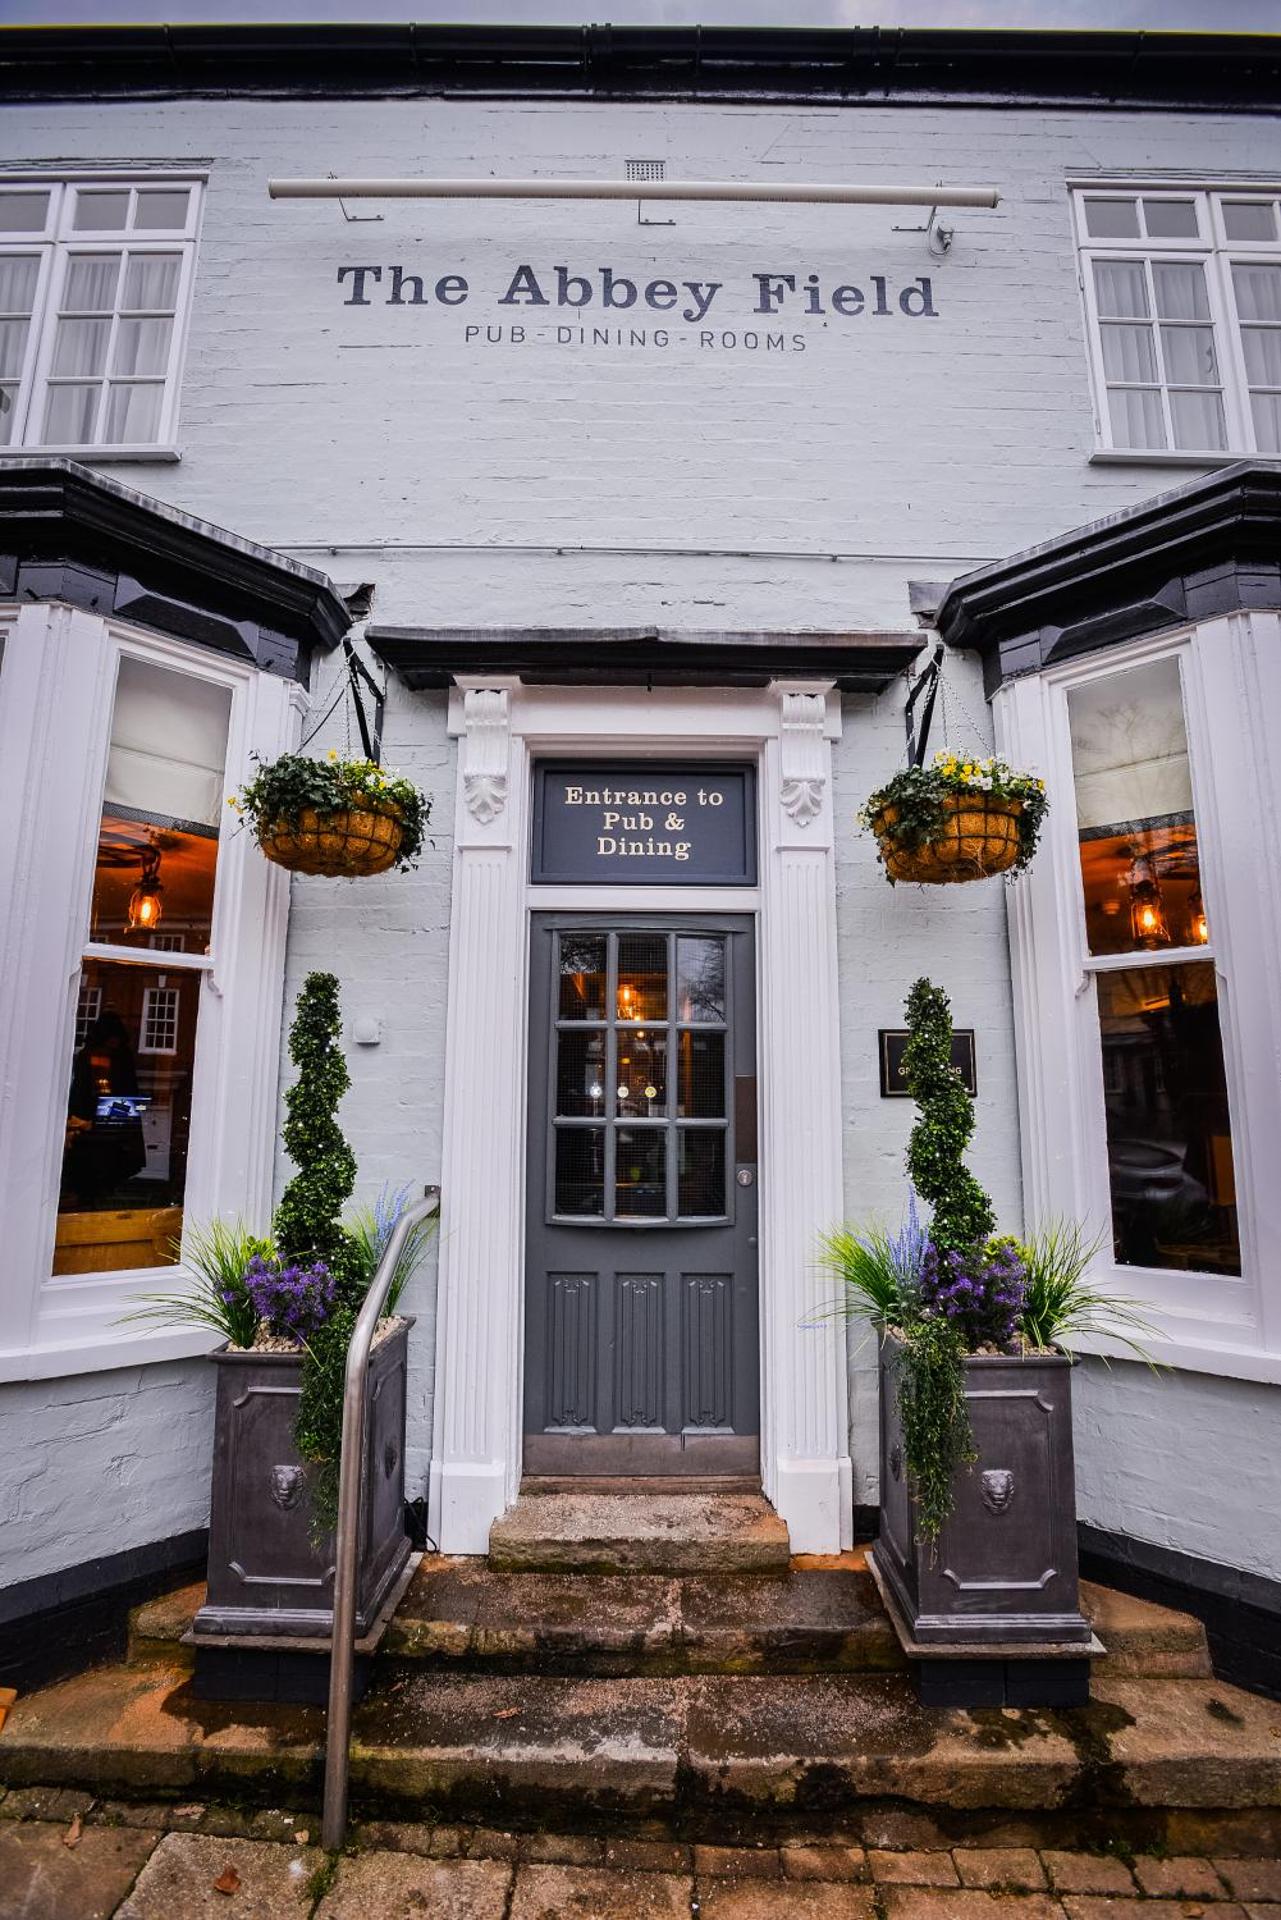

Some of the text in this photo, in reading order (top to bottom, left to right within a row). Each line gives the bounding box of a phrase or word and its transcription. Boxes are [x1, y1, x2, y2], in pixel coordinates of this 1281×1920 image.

[337, 265, 940, 322] The Abbey Field
[564, 786, 724, 806] Entrance to
[603, 812, 685, 831] Pub &
[597, 837, 691, 861] Dining
